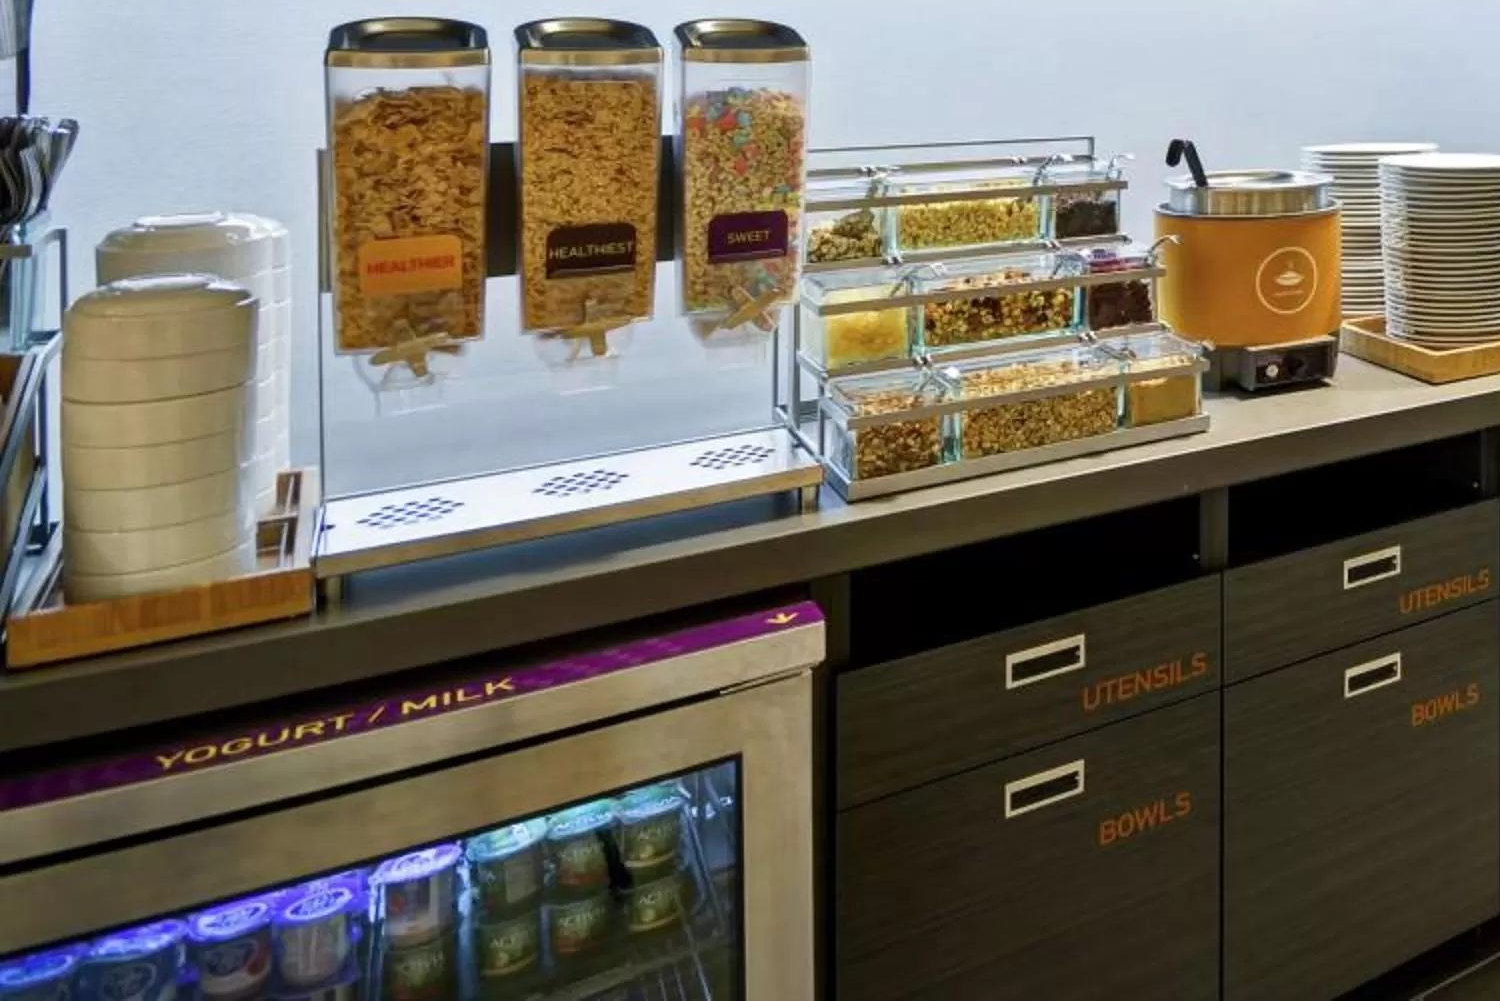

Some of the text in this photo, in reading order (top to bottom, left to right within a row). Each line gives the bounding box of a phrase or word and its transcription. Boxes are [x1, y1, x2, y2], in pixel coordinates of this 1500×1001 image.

[549, 241, 634, 260] HEALTHIEST
[727, 230, 770, 245] SWEET
[366, 254, 456, 275] HEALTHIER
[1399, 569, 1490, 614] UTENSILS
[1083, 652, 1207, 711] UTENSILS
[156, 676, 516, 771] YOGURT / MILK
[1411, 683, 1480, 728] BOWLS
[1099, 791, 1193, 847] BOWLS
